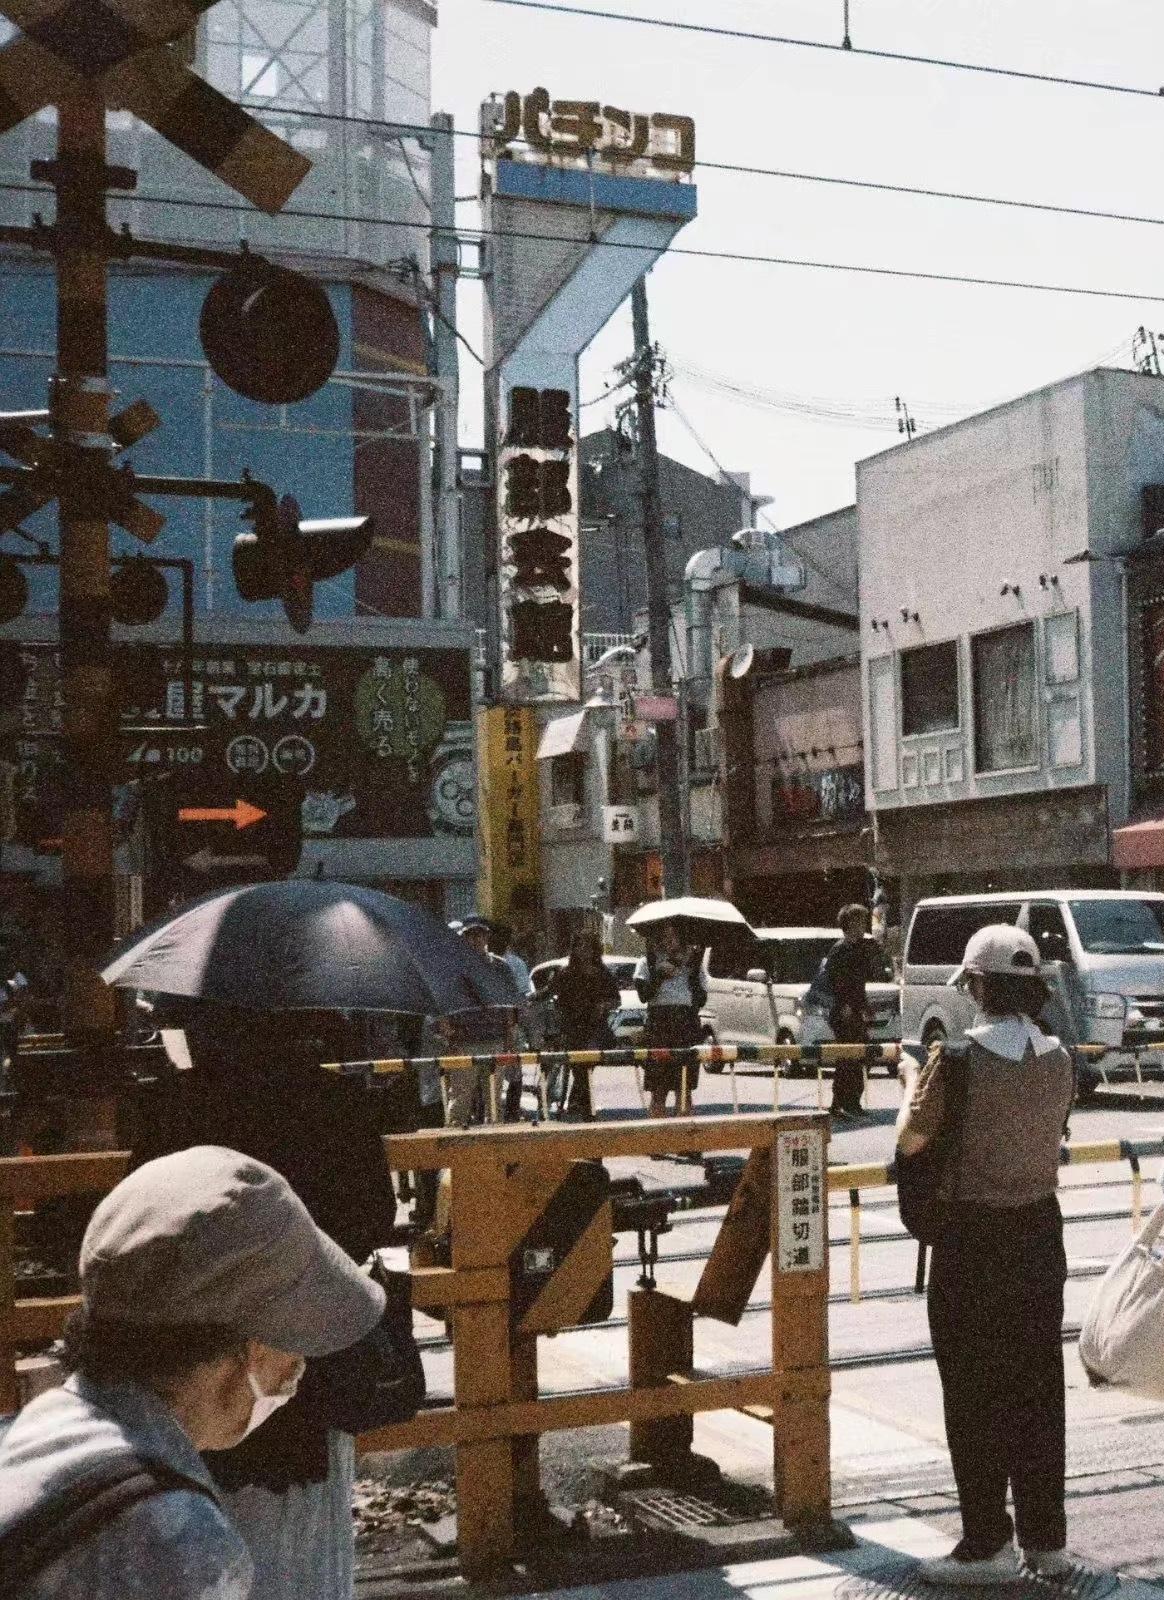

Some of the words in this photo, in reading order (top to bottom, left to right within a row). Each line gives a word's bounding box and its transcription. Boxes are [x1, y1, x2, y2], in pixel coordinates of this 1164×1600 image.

[493, 86, 696, 172] パチンコ
[372, 655, 395, 758] 高く売る
[791, 1148, 811, 1266] 服部踏切道
